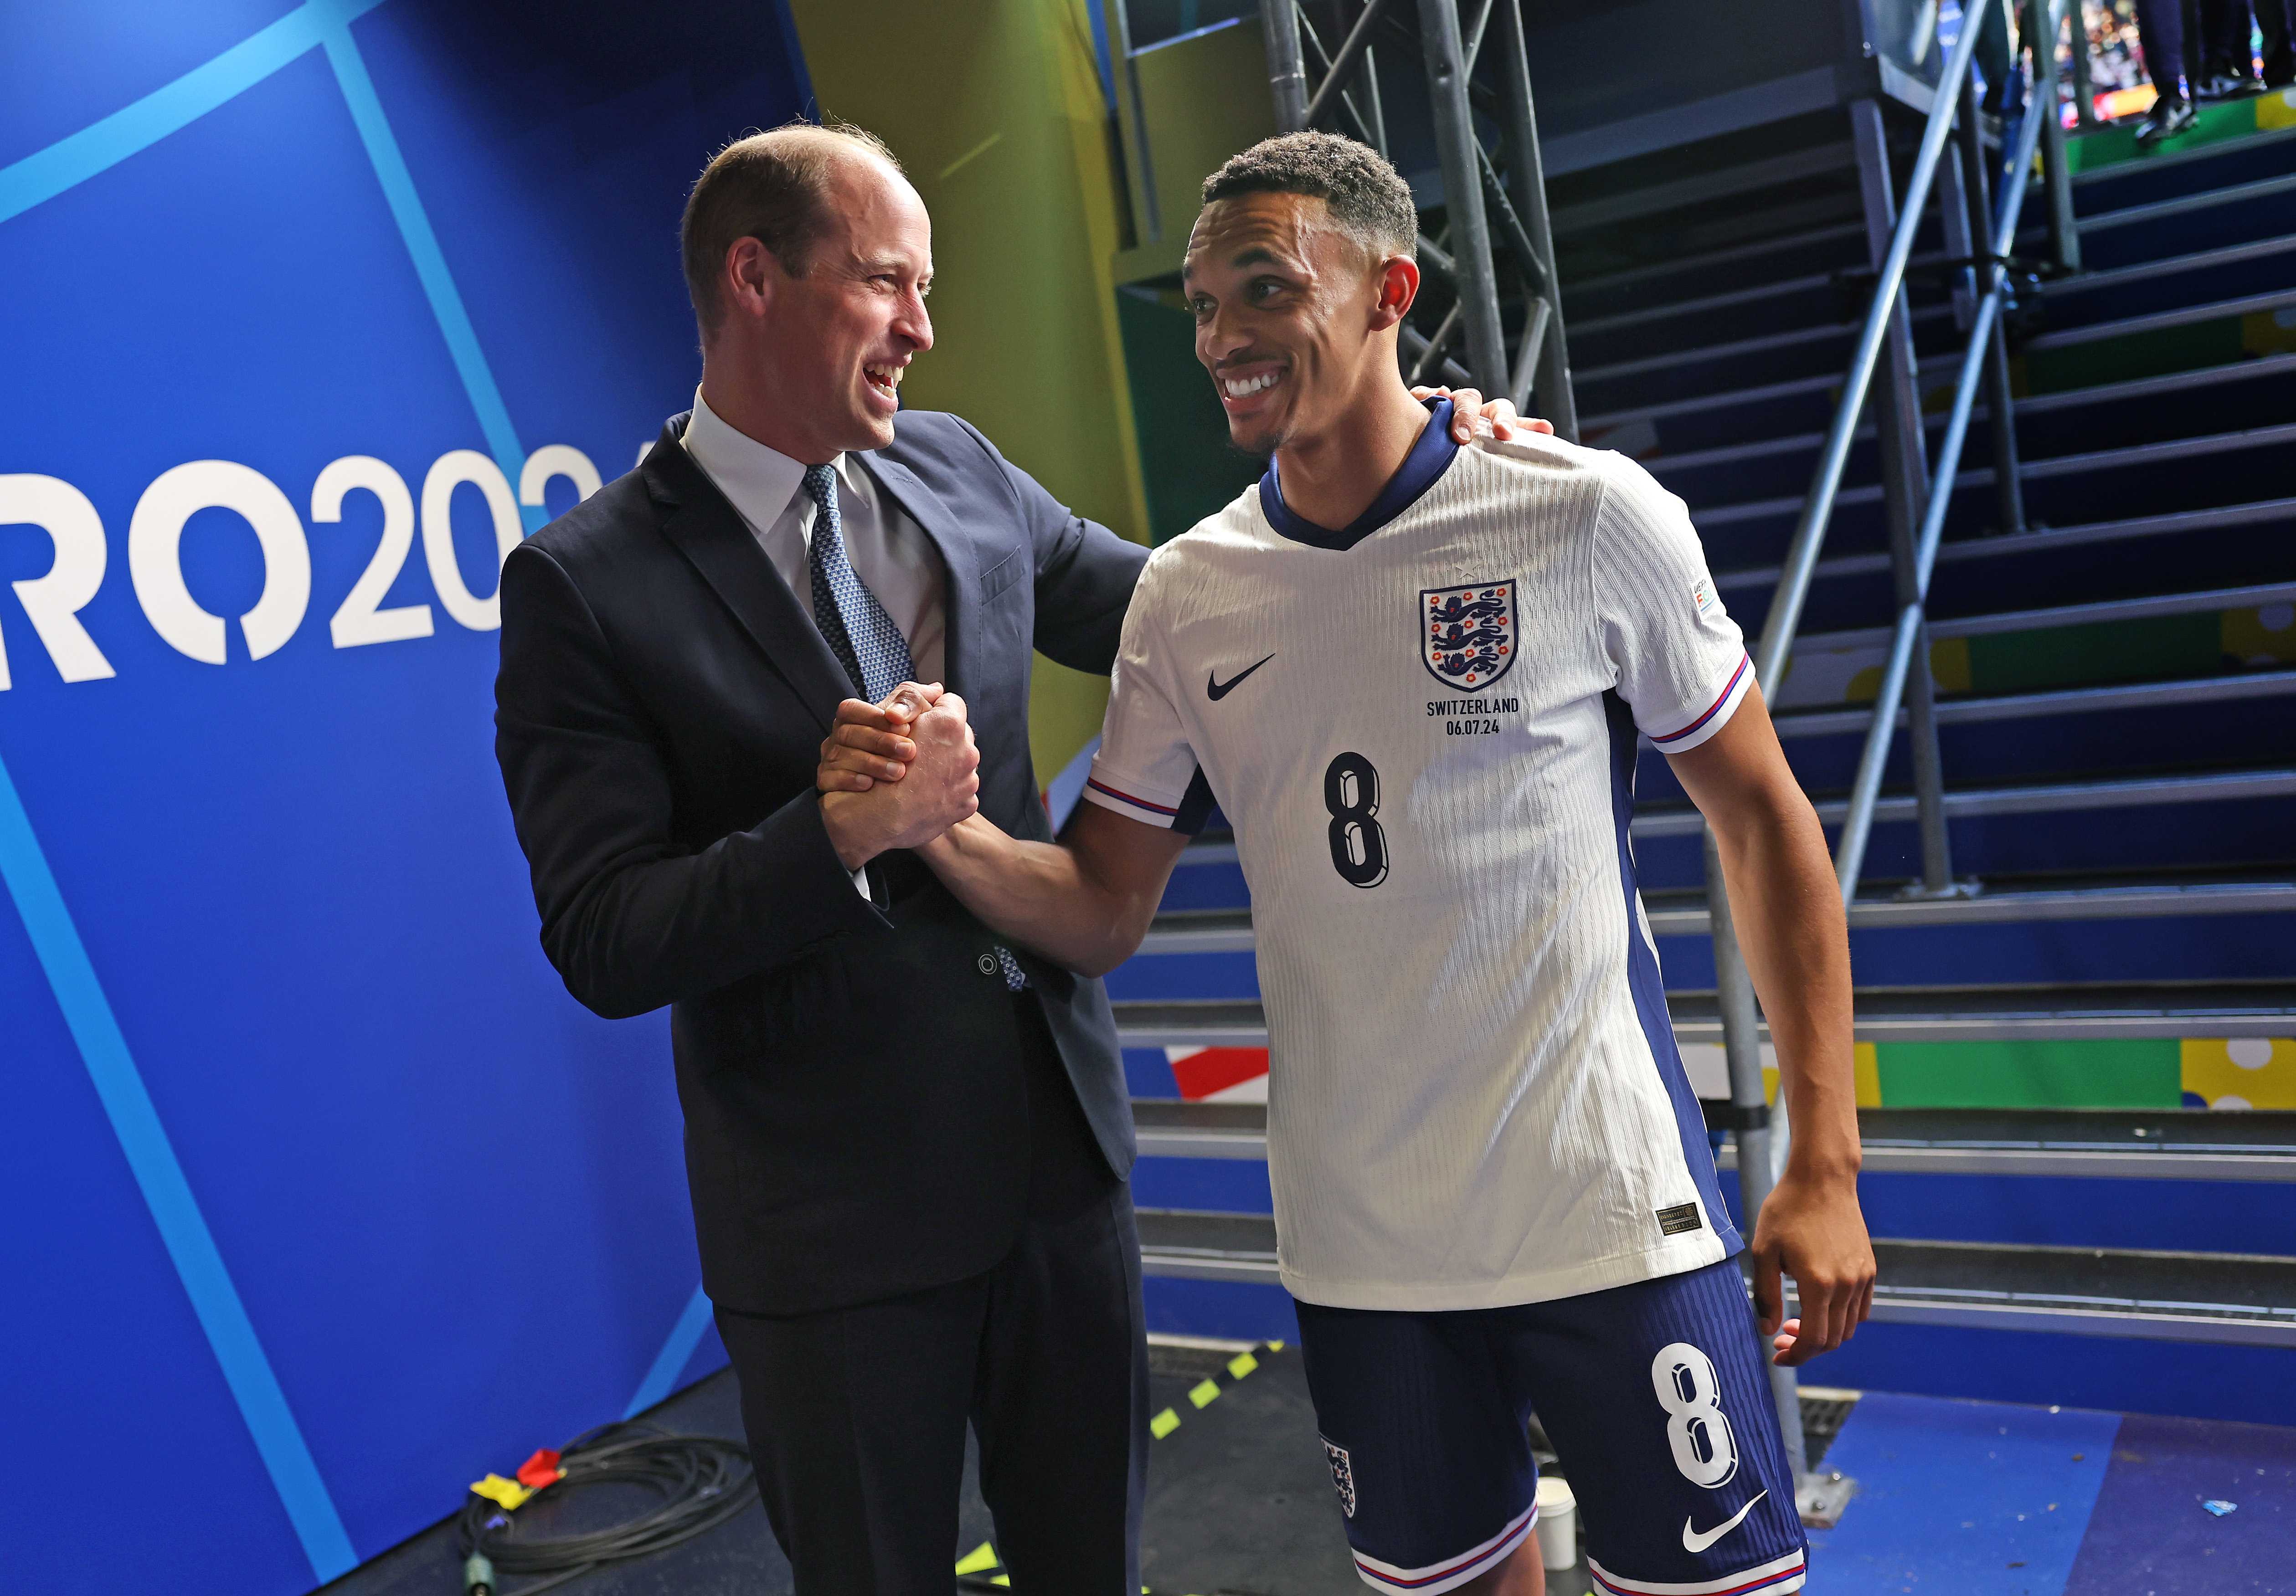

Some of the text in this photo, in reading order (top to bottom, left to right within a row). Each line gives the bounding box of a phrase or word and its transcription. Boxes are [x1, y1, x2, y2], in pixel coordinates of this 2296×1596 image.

[1427, 698, 1519, 716] SWITZERLAND
[1447, 719, 1499, 735] 06.07.24
[1324, 752, 1389, 888] 8
[1652, 1342, 1739, 1489] 8
